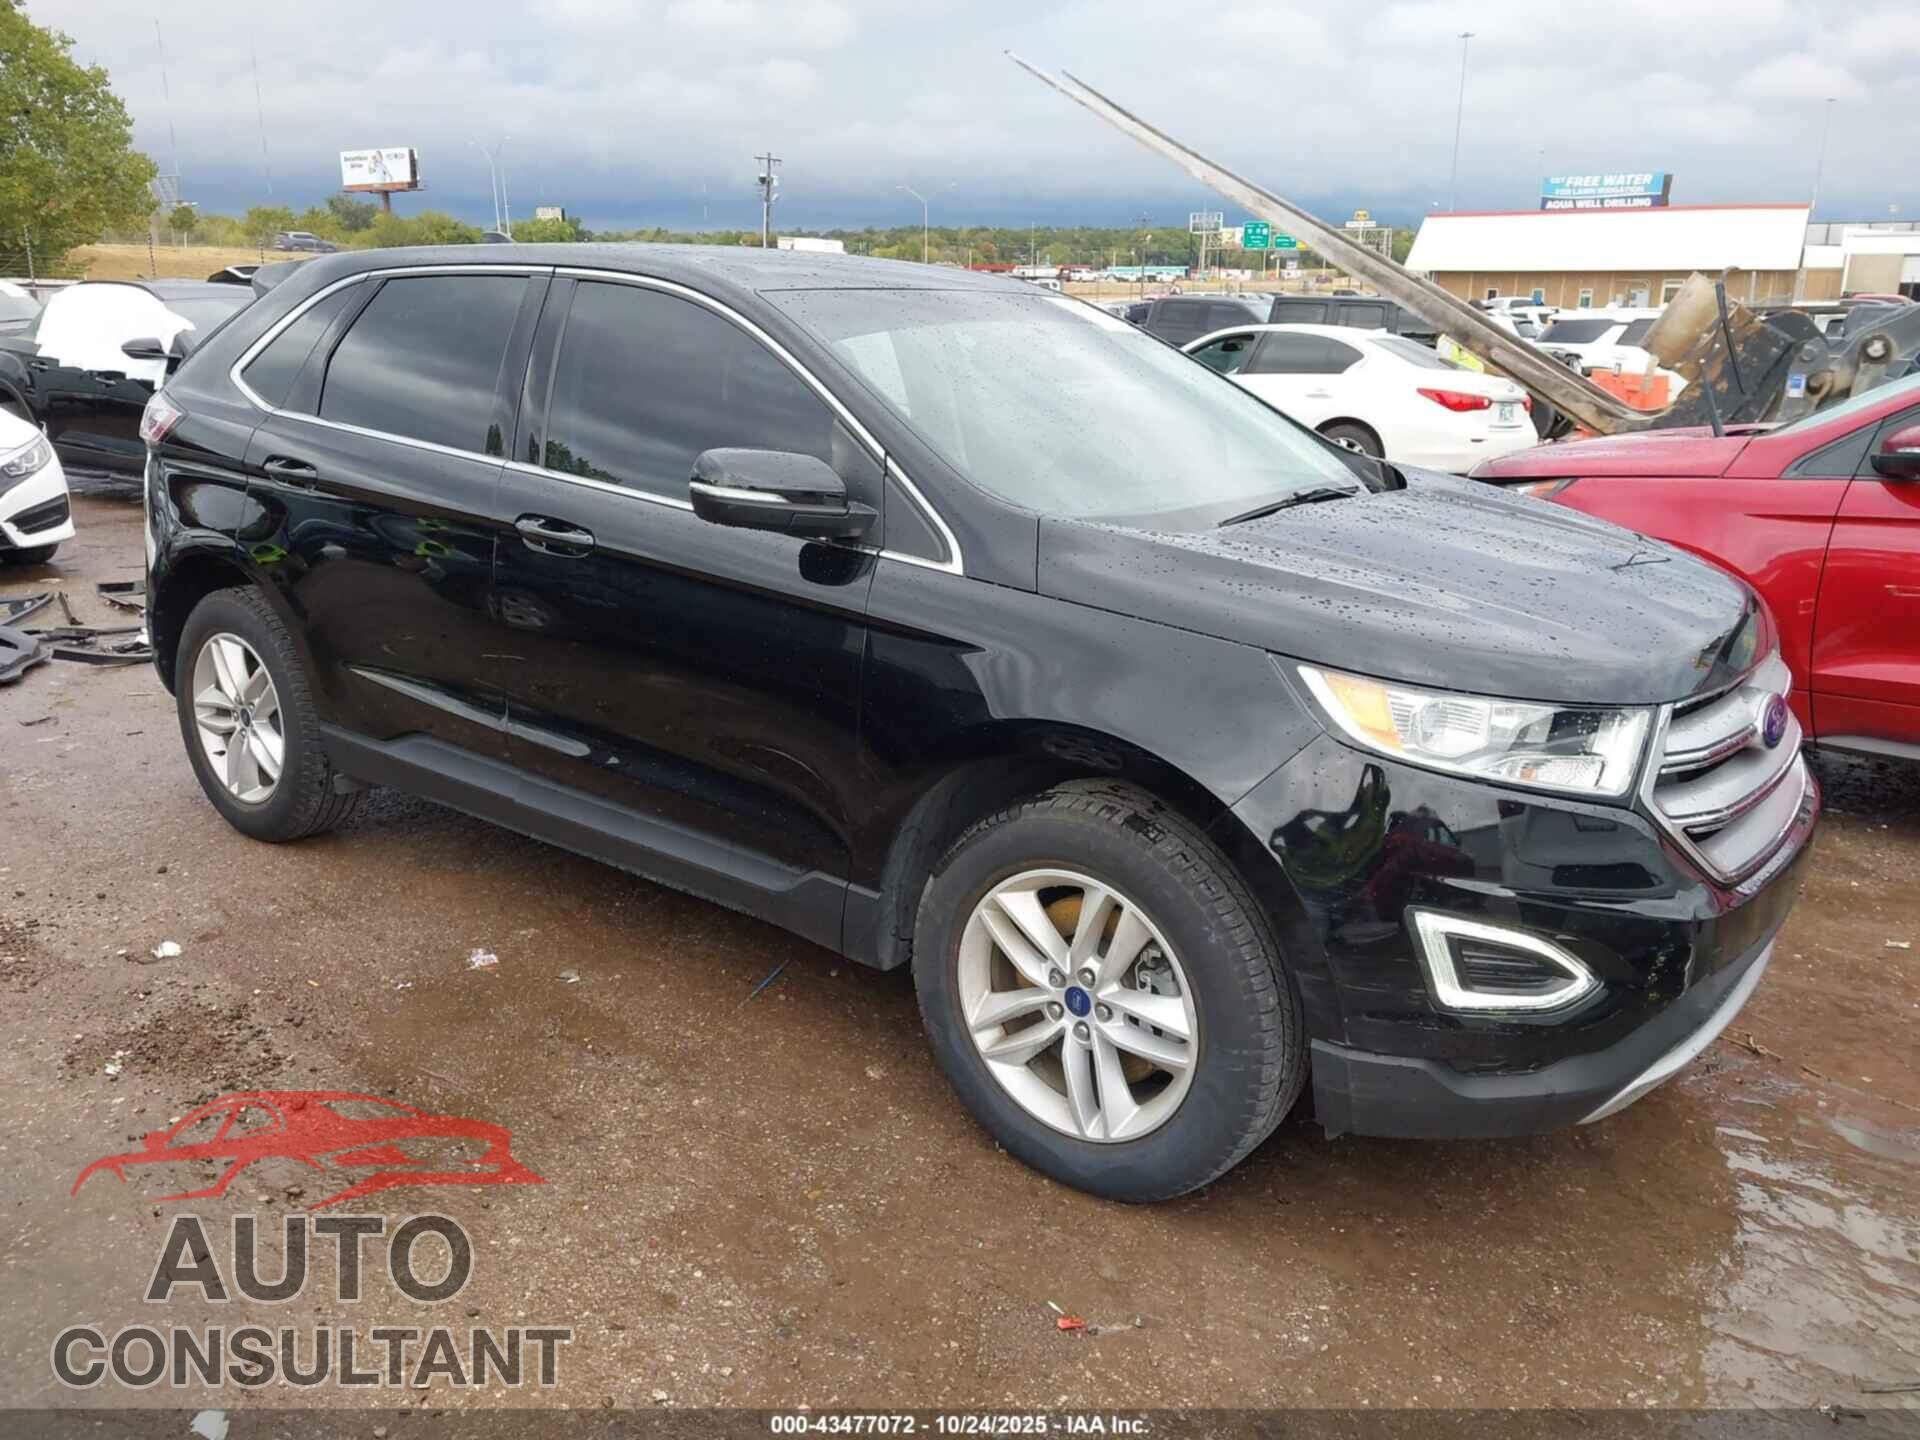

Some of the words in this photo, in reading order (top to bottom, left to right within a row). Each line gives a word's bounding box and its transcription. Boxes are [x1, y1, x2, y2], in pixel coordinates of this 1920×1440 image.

[1566, 175, 1601, 187] FREE
[1603, 173, 1653, 186] WATER
[1545, 199, 1575, 209] AQUA
[1576, 198, 1601, 208] WELL
[1603, 197, 1652, 208] DRILLING
